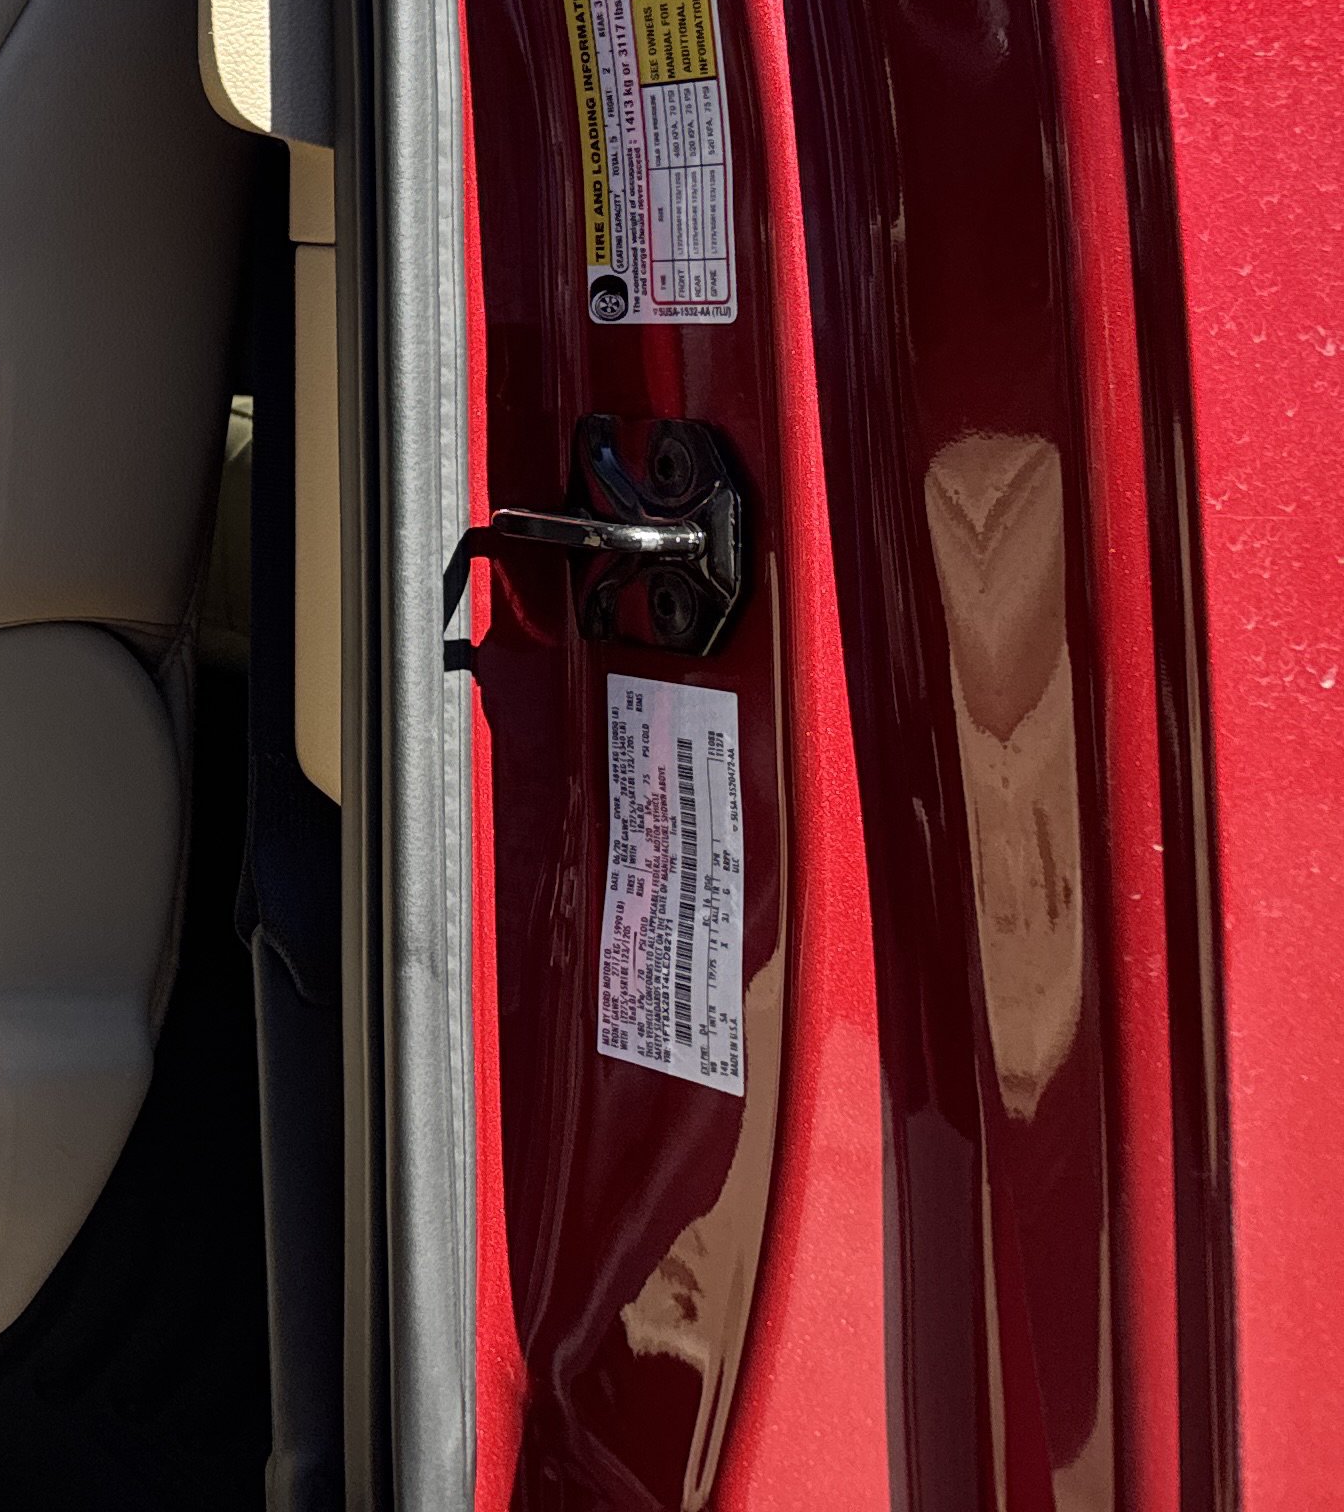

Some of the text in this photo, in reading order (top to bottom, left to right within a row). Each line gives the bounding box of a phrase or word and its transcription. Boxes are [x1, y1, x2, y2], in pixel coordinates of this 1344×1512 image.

[615, 24, 627, 56] 3117
[643, 6, 659, 80] SEE OWNERS
[660, 3, 675, 79] MANUAL FOR
[677, 2, 692, 73] ADDITIONAL
[623, 62, 631, 75] or
[623, 80, 633, 96] kg
[623, 100, 635, 133] 1413
[585, 98, 602, 175] LOADING
[592, 180, 603, 216] AND
[594, 222, 606, 262] TIRE
[620, 843, 628, 862] REAR
[659, 895, 667, 915] DATE
[640, 916, 648, 938] COLD
[647, 935, 655, 949] ALL
[656, 932, 663, 946] ON
[612, 956, 620, 976] 2717
[647, 950, 654, 961] TO
[603, 961, 611, 989] MOTOR
[637, 969, 645, 981] 70
[604, 1014, 610, 1024] BY
[611, 1023, 619, 1048] FRONT
[730, 1054, 738, 1077] MADE
